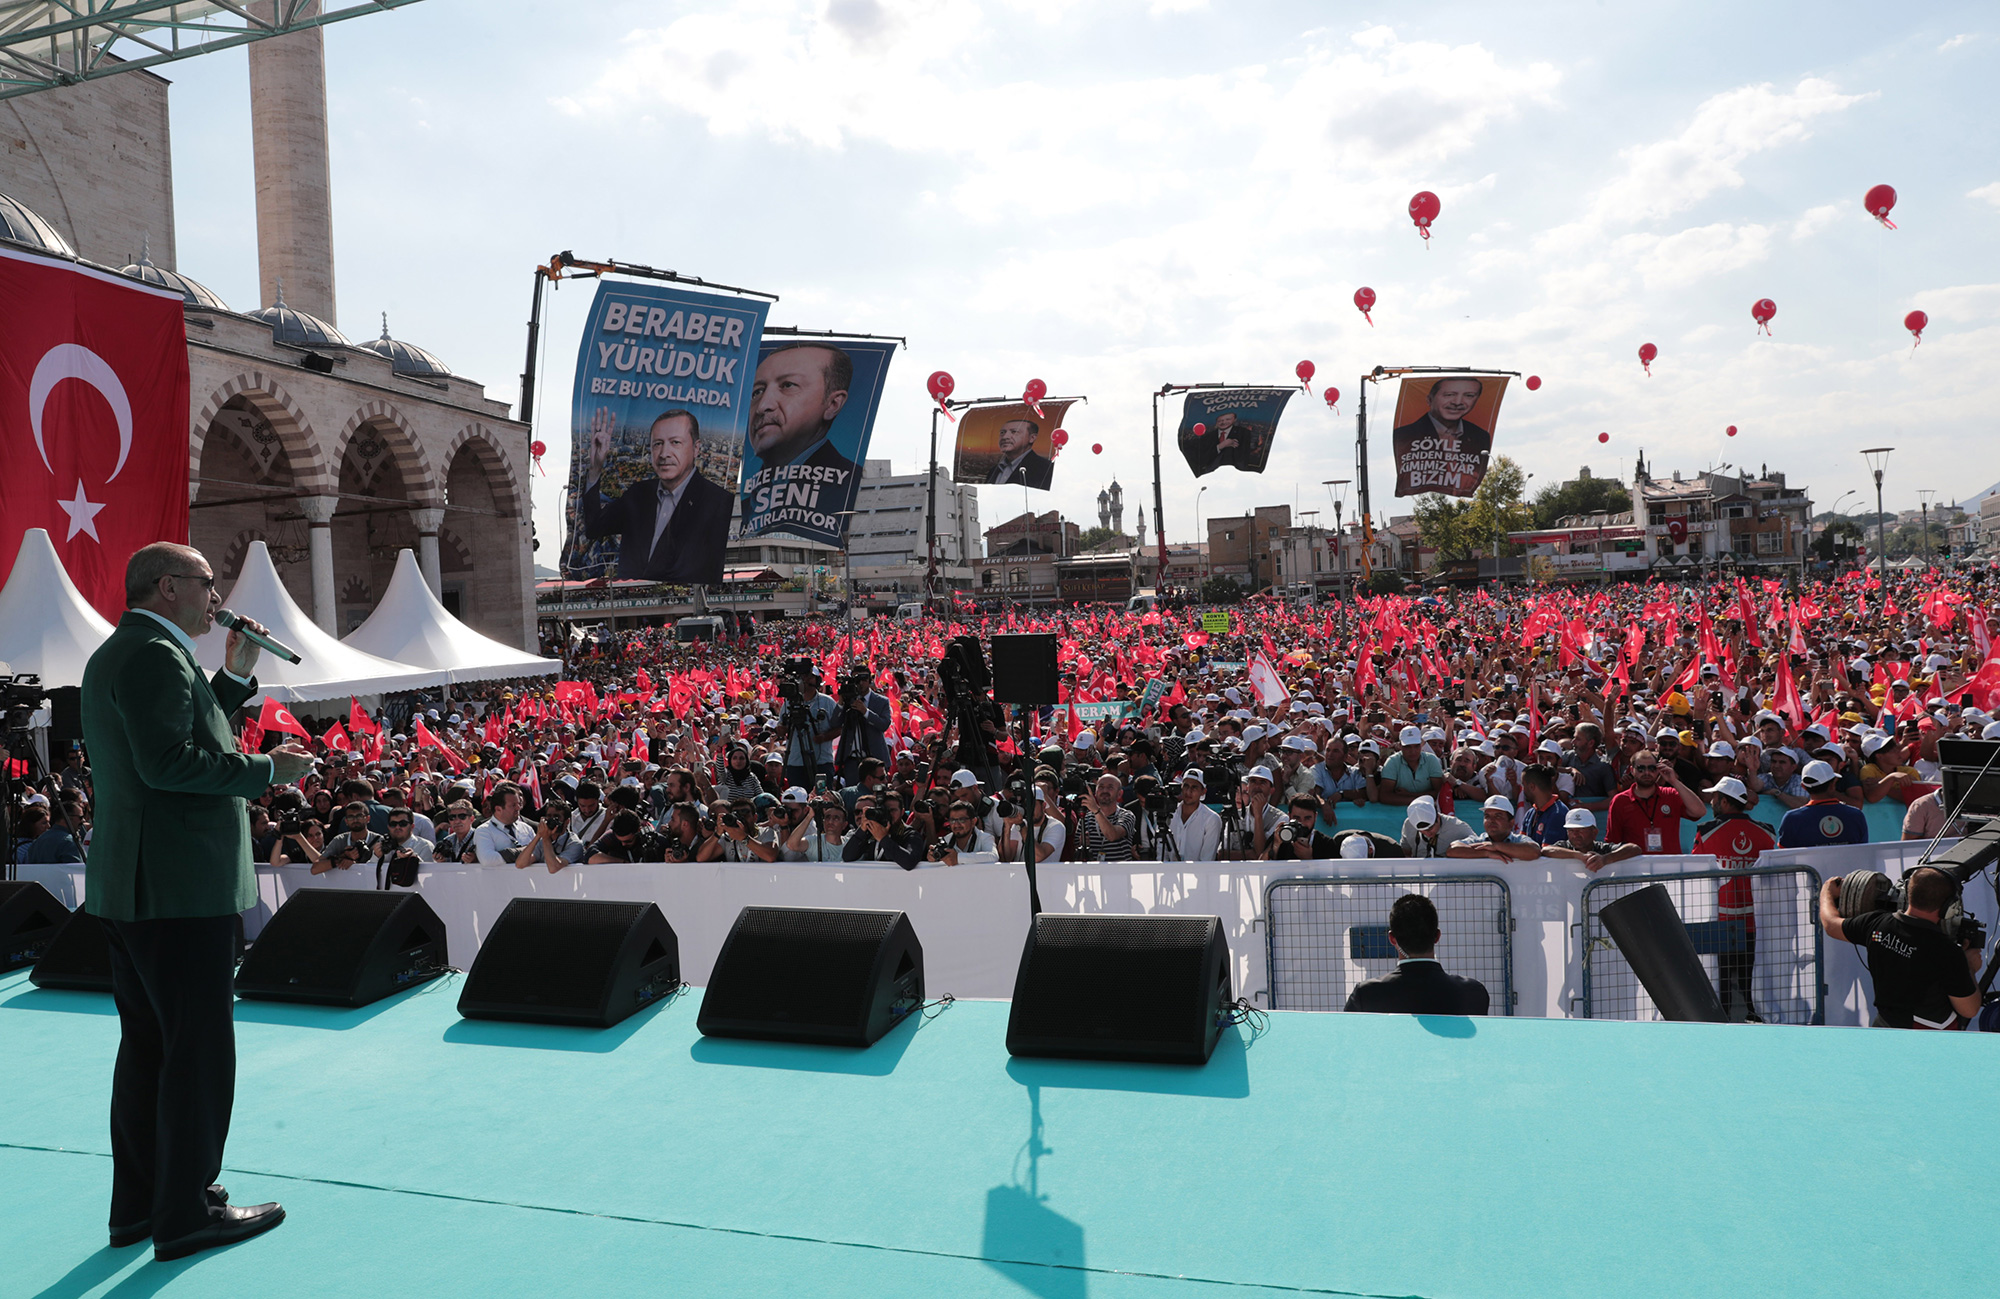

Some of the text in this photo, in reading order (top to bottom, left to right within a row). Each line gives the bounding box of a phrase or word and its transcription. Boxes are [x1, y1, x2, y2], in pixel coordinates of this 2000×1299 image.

[603, 302, 745, 347] BERABER
[598, 338, 738, 384] YÜRÜDÜK
[618, 380, 643, 397] BU
[645, 382, 731, 408] YOLLARDA
[1206, 401, 1259, 414] KONYA
[1410, 436, 1462, 452] SÖYLE
[1445, 453, 1480, 465] BAŞKA
[1449, 461, 1475, 475] VAR
[774, 465, 849, 485] HERŞEY
[1410, 471, 1462, 488] BİZİM
[740, 508, 836, 535] HATIRLATIYOR
[635, 599, 659, 607] AVM
[1882, 933, 1913, 955] Altus
